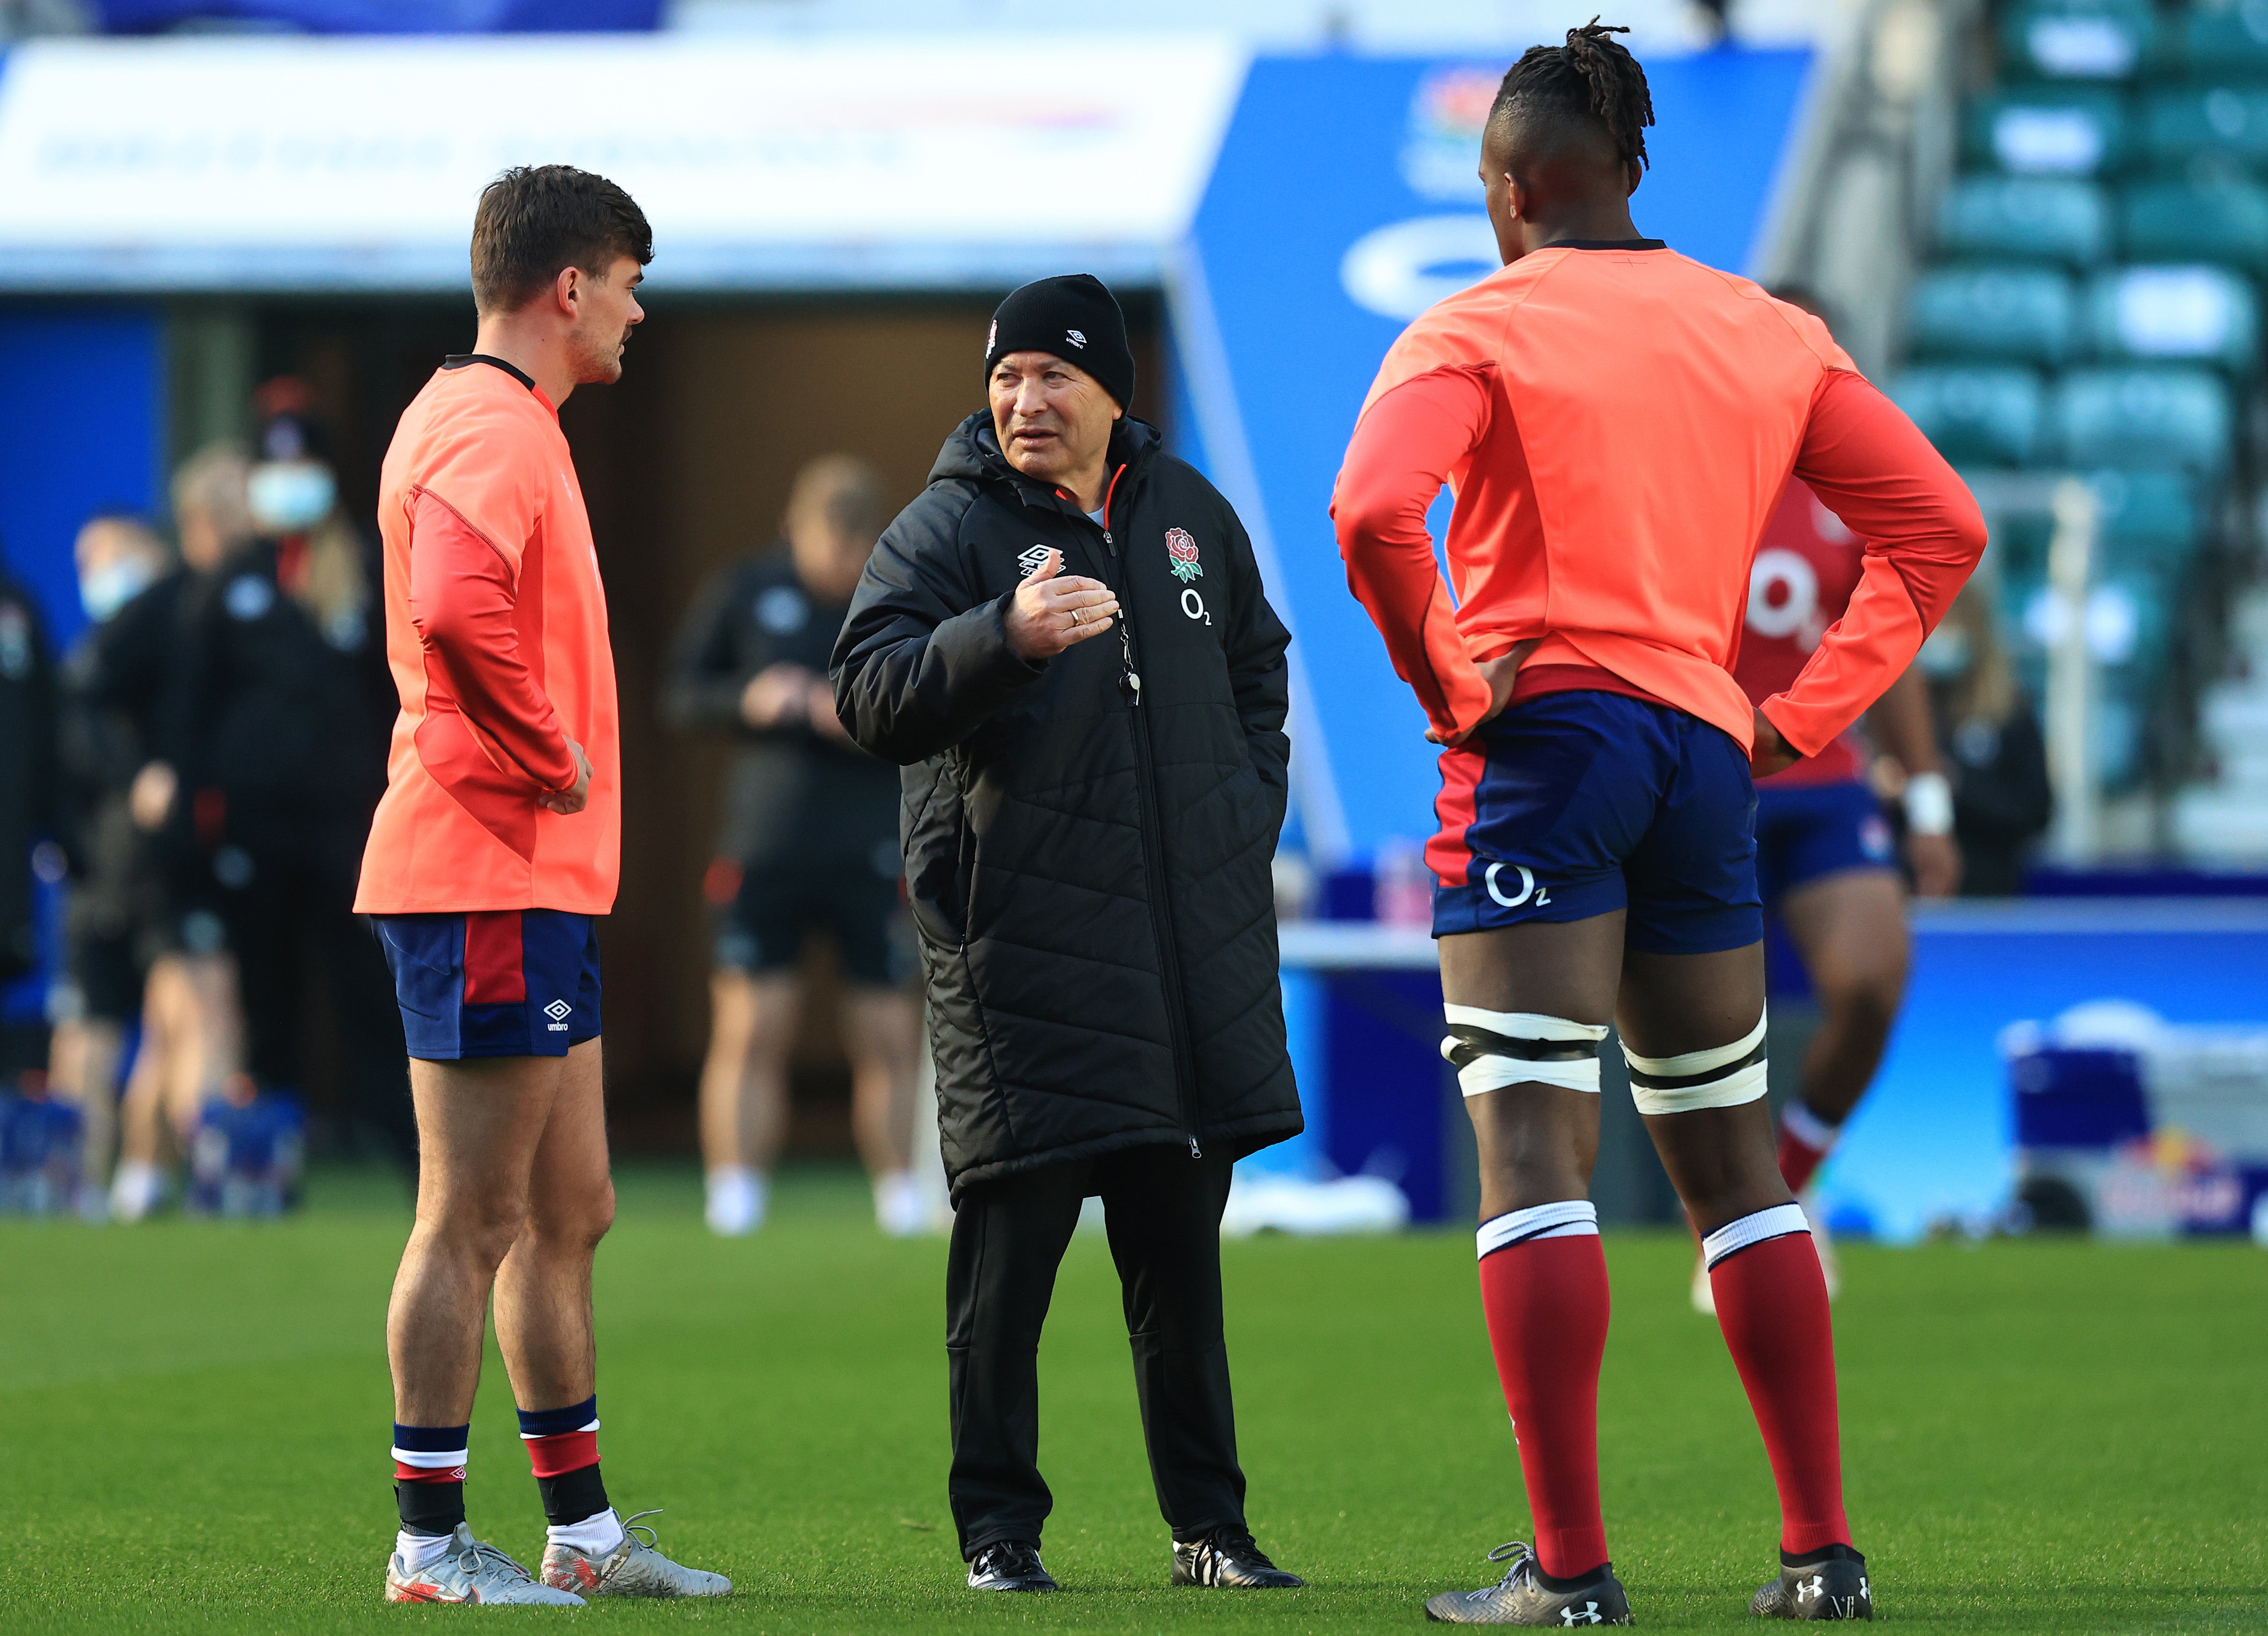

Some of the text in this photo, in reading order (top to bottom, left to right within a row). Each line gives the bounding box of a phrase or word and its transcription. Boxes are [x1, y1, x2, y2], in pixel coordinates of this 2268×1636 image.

[1066, 337, 1084, 350] umbro
[1180, 588, 1213, 626] O2
[1485, 862, 1551, 907] O2
[547, 1021, 568, 1031] umbro
